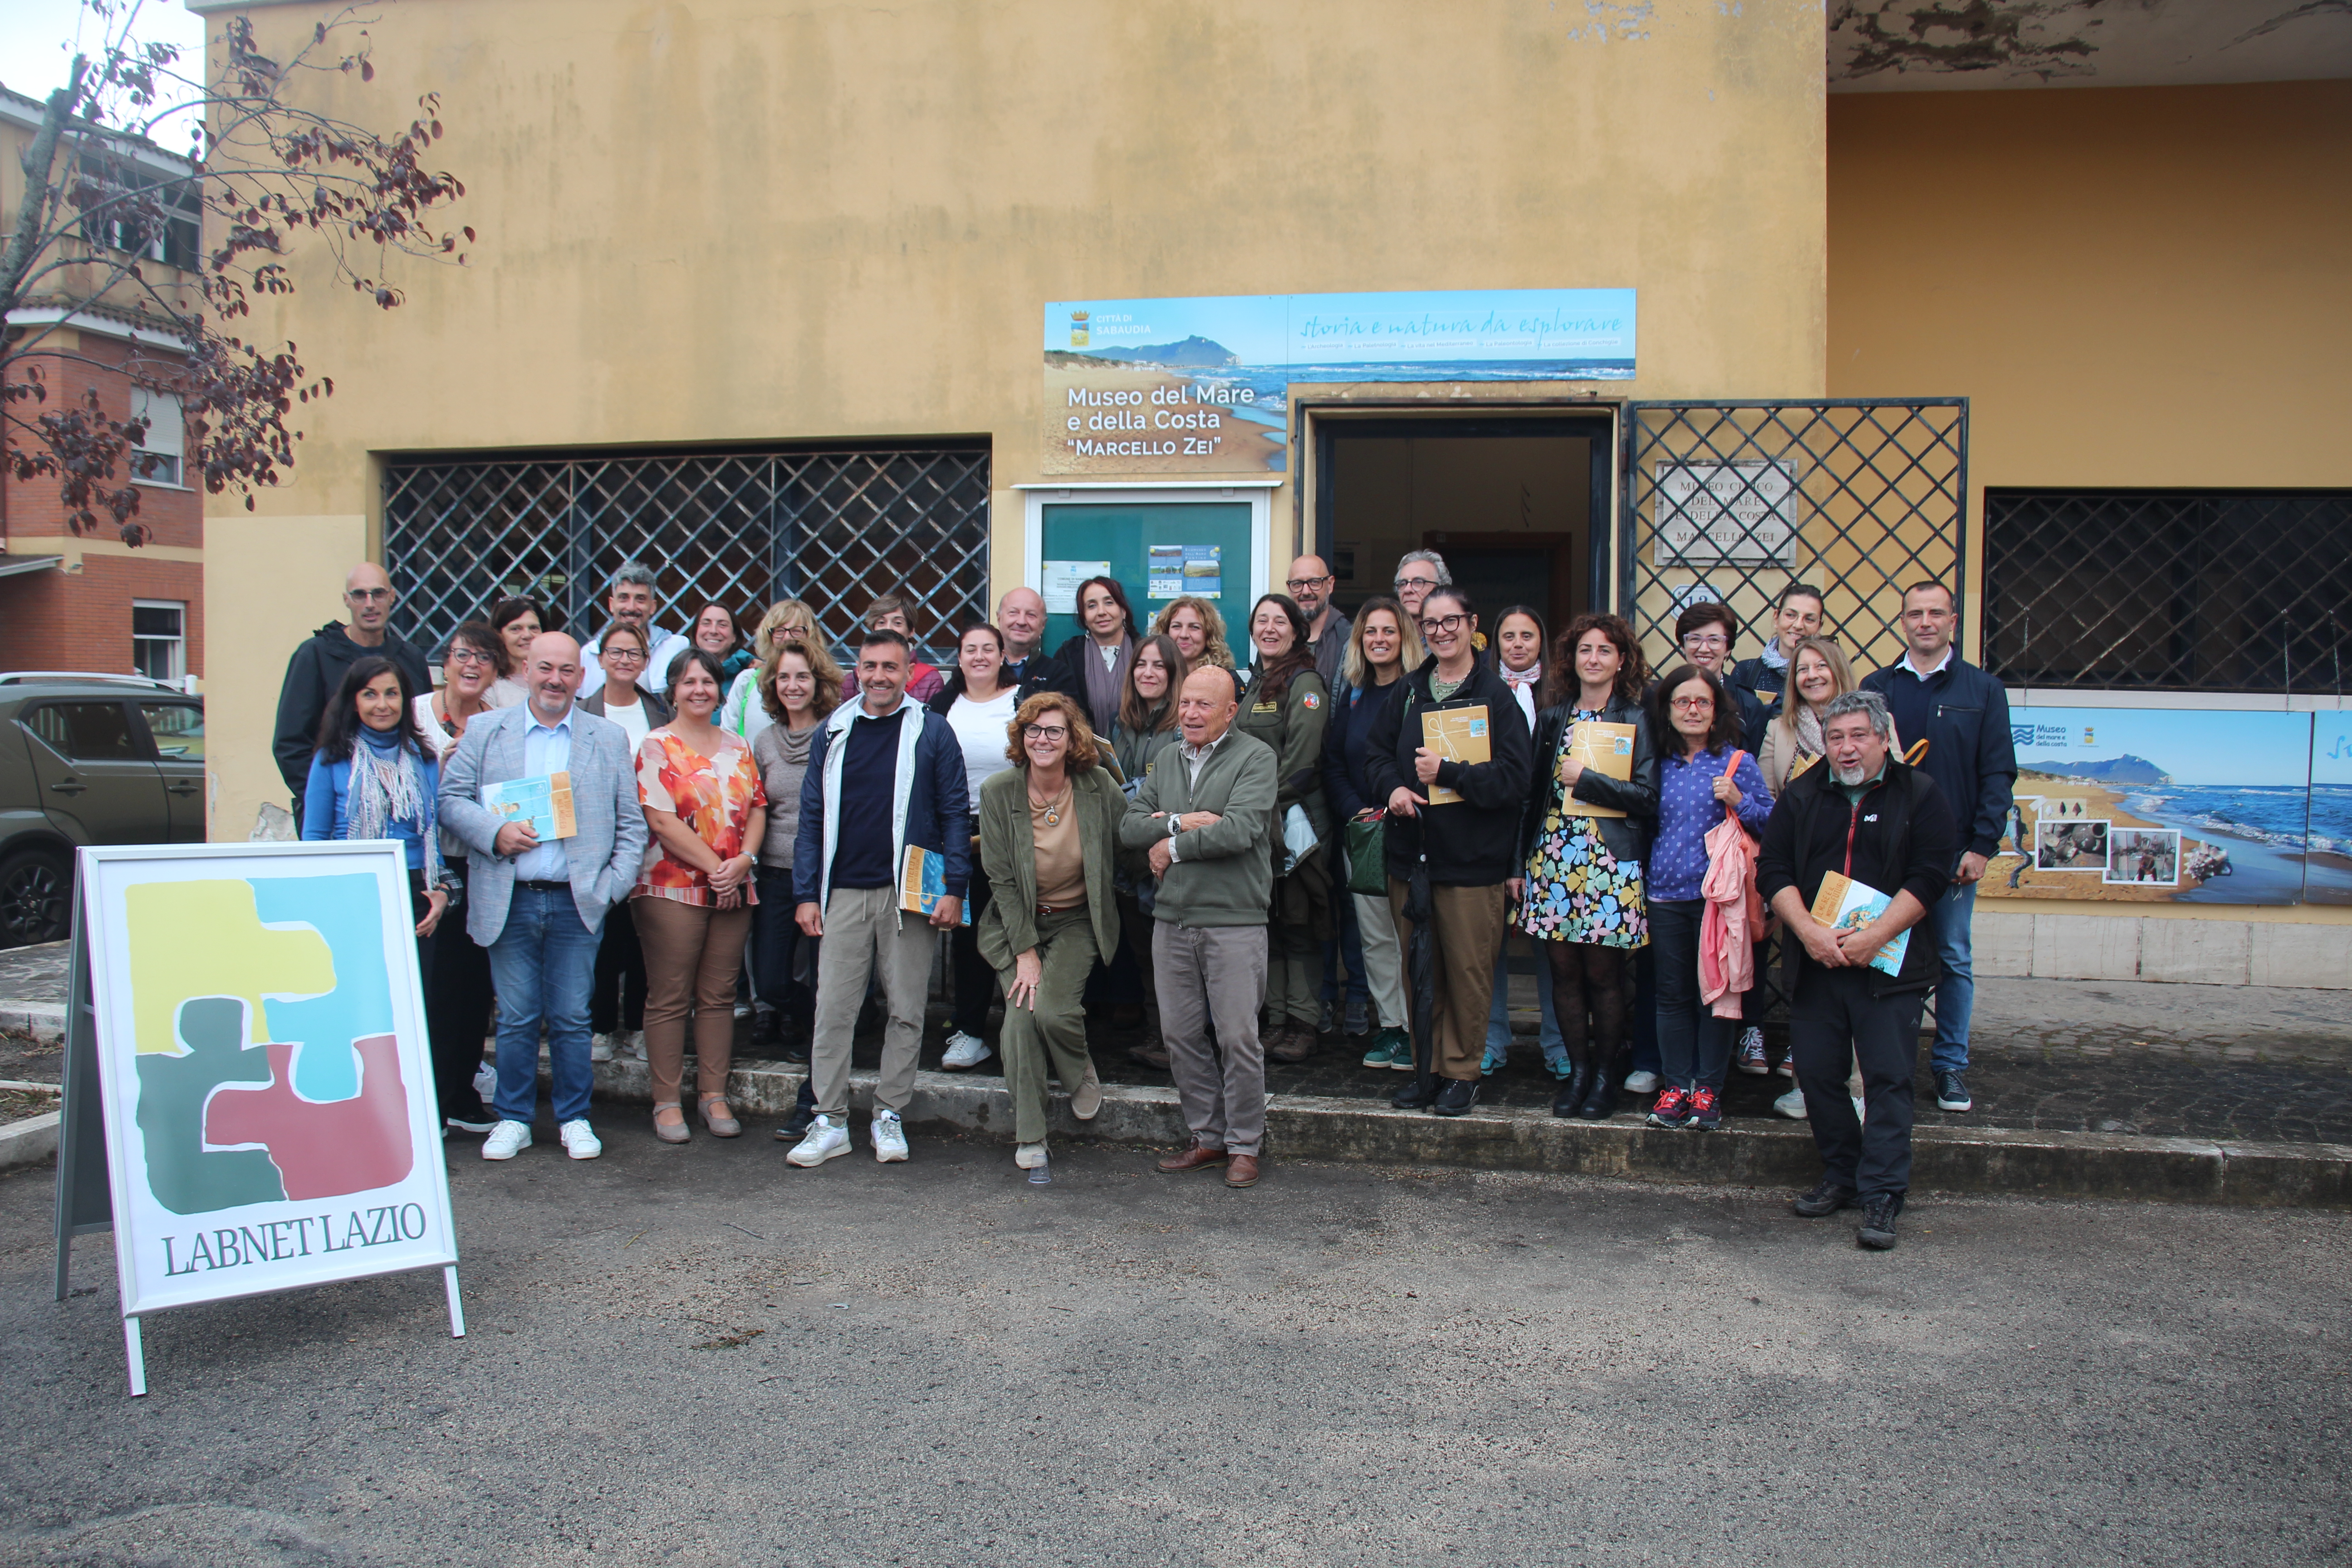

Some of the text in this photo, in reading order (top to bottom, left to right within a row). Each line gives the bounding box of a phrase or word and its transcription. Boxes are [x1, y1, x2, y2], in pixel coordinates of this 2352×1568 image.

[1096, 313, 1121, 323] CITTÀ
[1096, 325, 1151, 335] SABAUDIA
[1300, 307, 1622, 351] storia e natura da esplorare
[1588, 338, 1618, 347] Conchiglie
[1068, 384, 1254, 407] Museo del Mare
[1067, 409, 1220, 431] e della Costa
[1680, 482, 1773, 491] MUEO CIICO
[1691, 497, 1761, 506] DEL MARE
[1675, 511, 1682, 520] E
[1755, 532, 1774, 542] ZEI
[2036, 725, 2066, 733] Museo
[907, 861, 916, 883] CIELO
[1826, 901, 1836, 916] NOSTRO
[1832, 879, 1845, 902] FUTURO
[161, 1202, 427, 1277] LABNET LAZIO
